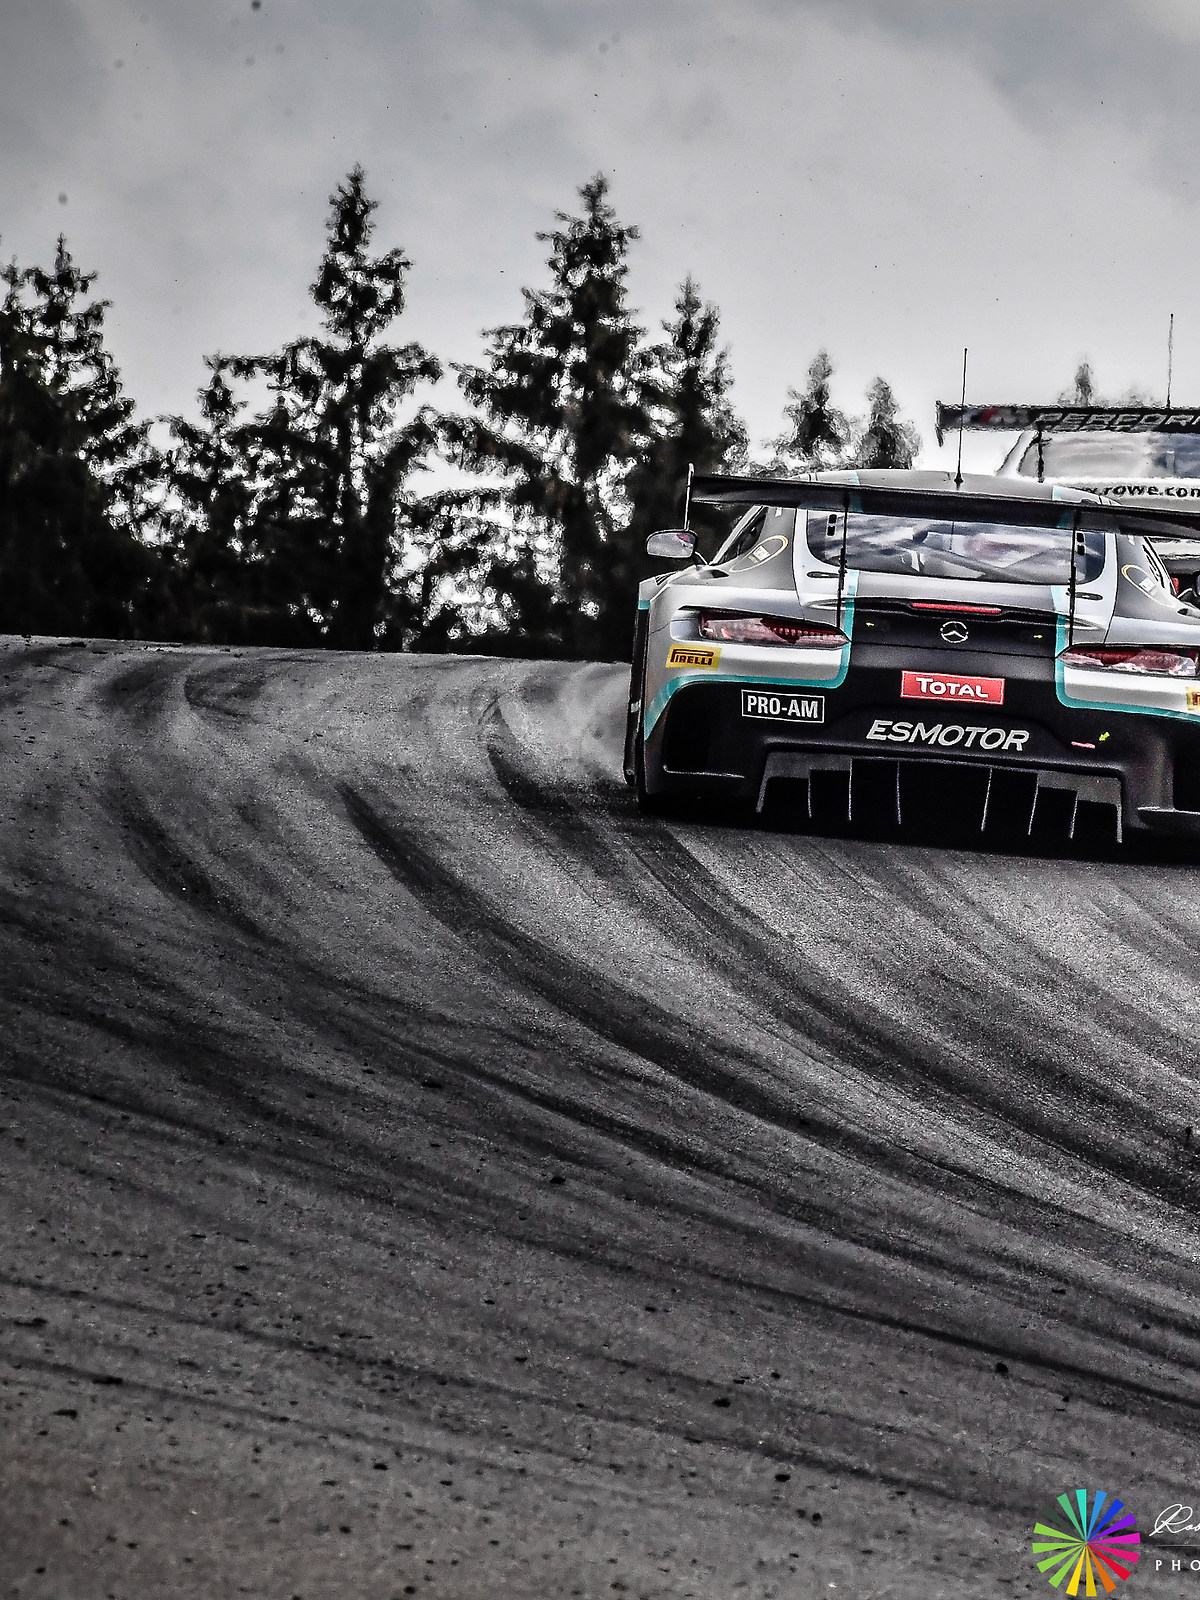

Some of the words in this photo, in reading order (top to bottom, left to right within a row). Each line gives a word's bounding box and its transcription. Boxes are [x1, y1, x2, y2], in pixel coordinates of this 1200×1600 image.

[670, 648, 714, 666] PIRELLI
[916, 677, 989, 698] TOTAL
[747, 695, 819, 719] PRO-AM
[866, 719, 1030, 751] ESMOTOR
